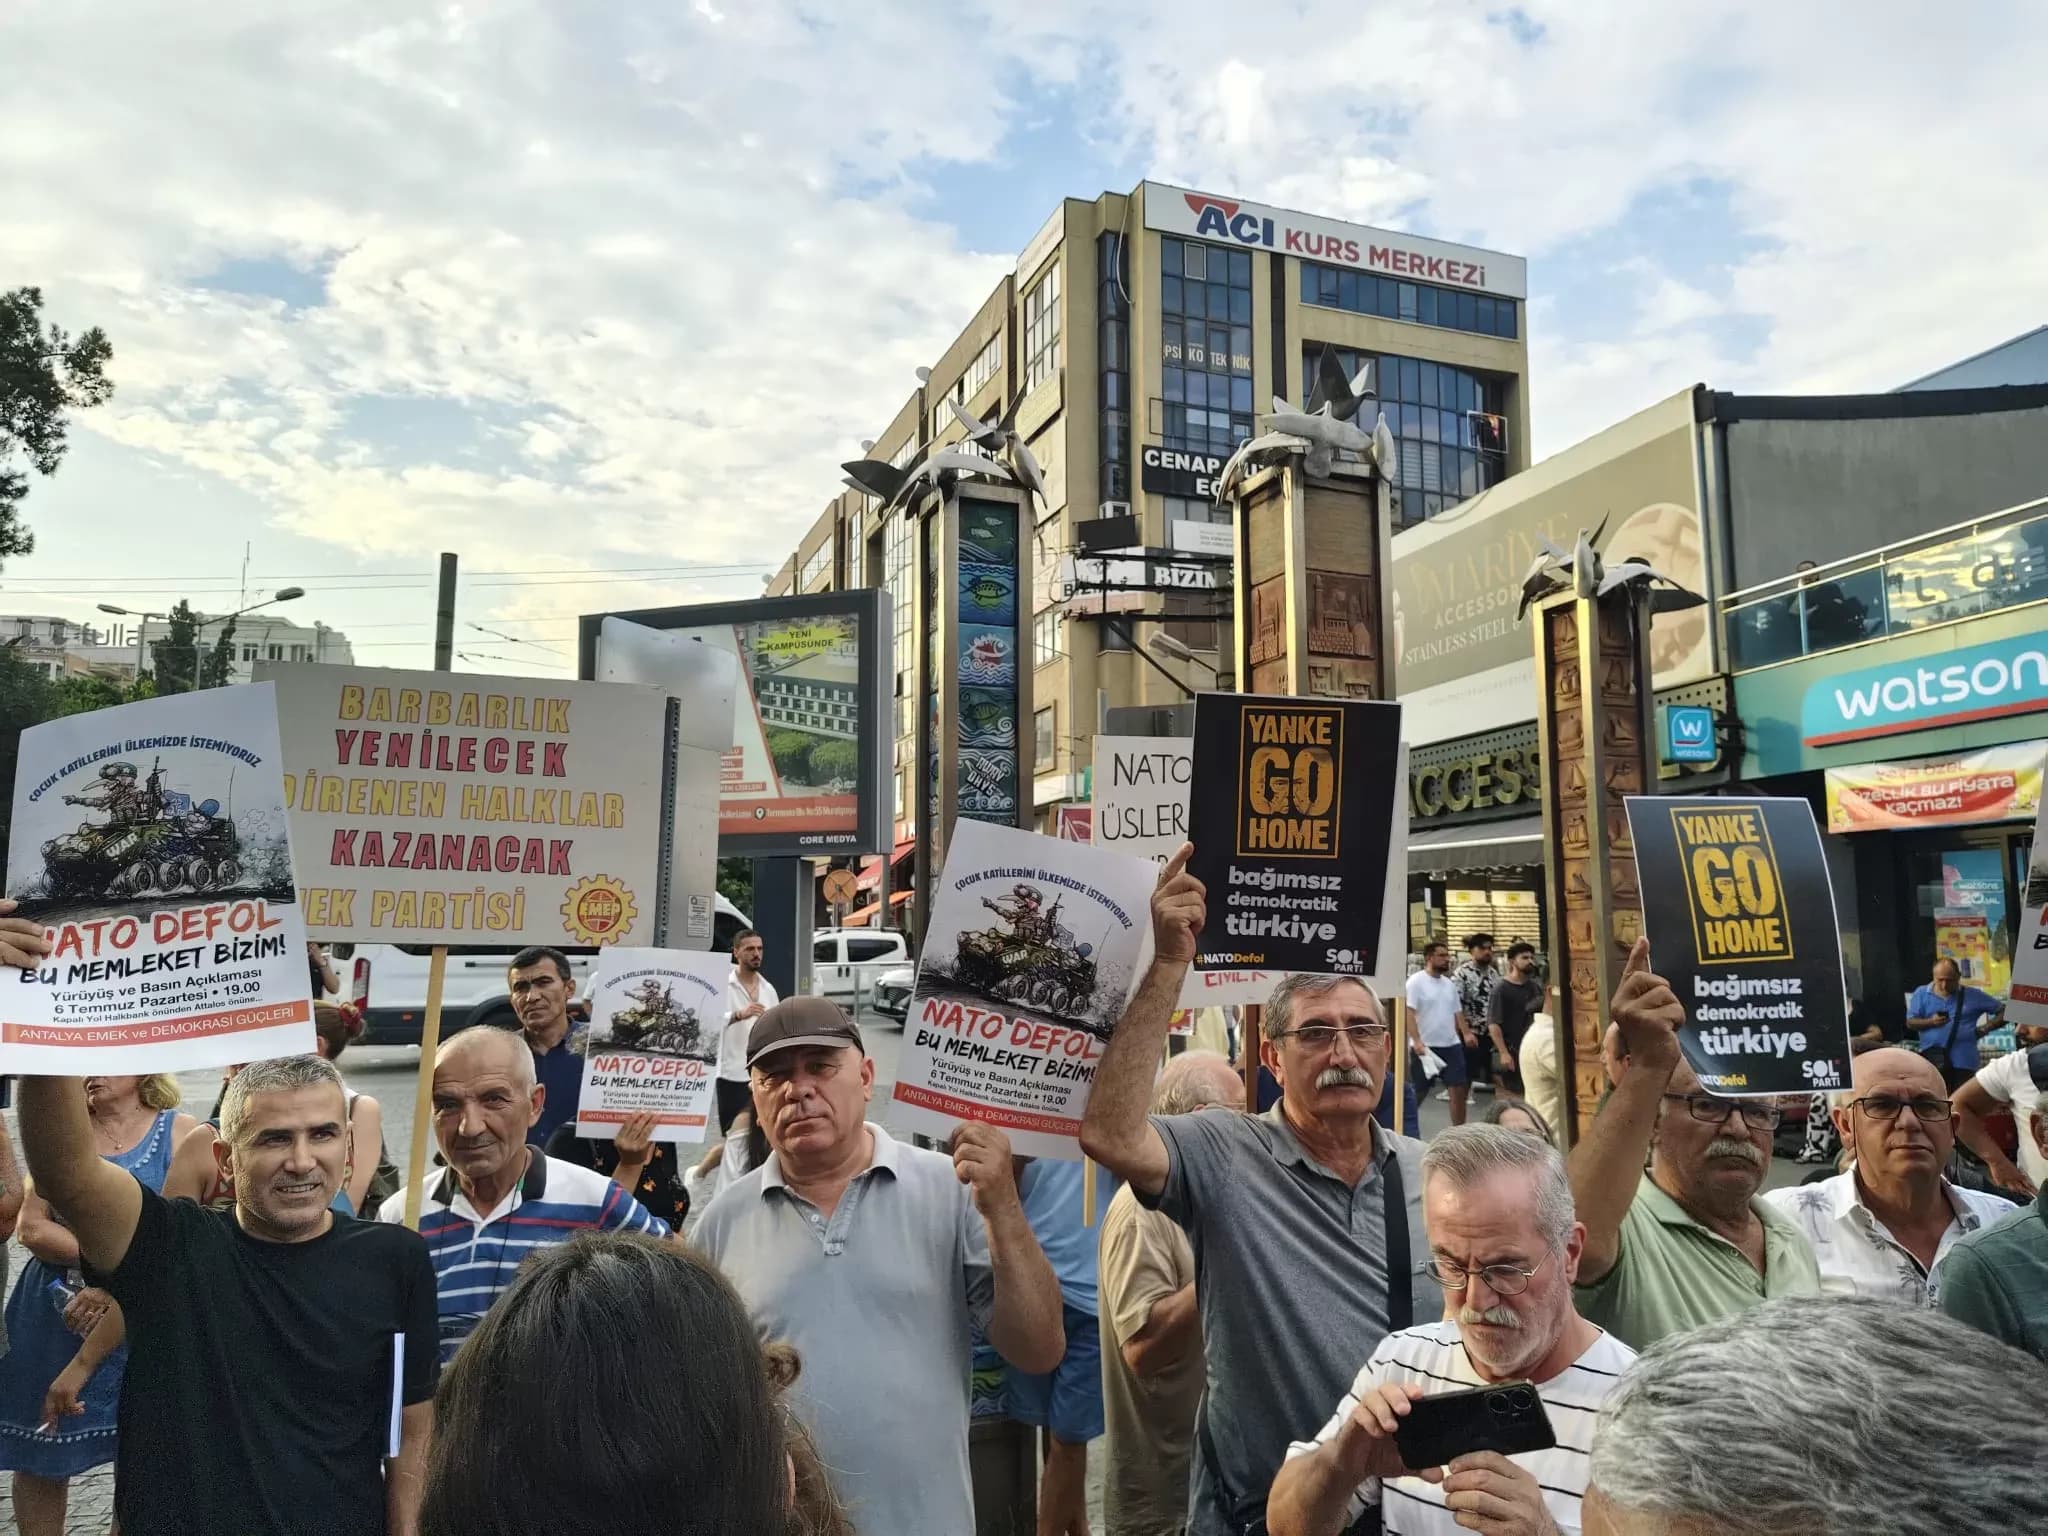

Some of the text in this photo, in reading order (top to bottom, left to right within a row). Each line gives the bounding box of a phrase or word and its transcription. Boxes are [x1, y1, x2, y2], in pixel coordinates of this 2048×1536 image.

[1196, 205, 1274, 247] ACI
[1285, 227, 1360, 263] KURS
[1209, 351, 1227, 367] TEK
[1144, 449, 1220, 474] CENAP
[1406, 631, 1467, 665] STAINLESS
[1470, 617, 1507, 645] STEEL
[338, 684, 572, 734] BARBARLIK
[1248, 714, 1333, 744] YANKE
[29, 735, 262, 803] ÇOCUK KATİLLERİNİ ÜLKEMİZDE İSTEMİYORUZ
[335, 728, 568, 778] YENİLECEK
[1113, 752, 1191, 786] NATO
[1249, 747, 1334, 817] GO
[460, 783, 625, 829] HALKLAR
[1101, 802, 1188, 841] ÜSLER
[106, 831, 138, 857] WAR
[799, 835, 857, 844] CORE MEDYA
[1249, 817, 1330, 850] HOME
[1679, 813, 1760, 845] YANKE
[330, 828, 573, 876] KAZANACAK
[1228, 866, 1342, 891] bağımsız
[1692, 845, 1777, 917] GO
[370, 885, 527, 931] PARTİSİ
[580, 901, 621, 917] EMEP
[955, 866, 1133, 931] ÇOCUK KATİLLERİNİ ÜLKEMİZDE İSTEMİYORUZ
[1227, 891, 1340, 912] demokratik
[154, 899, 283, 945] DEFOL
[1226, 912, 1337, 944] türkiye
[1704, 918, 1784, 954] HOME
[68, 945, 206, 985] MEMLEKET
[214, 932, 287, 965] BİZİM!
[1001, 949, 1029, 966] WAR
[1325, 948, 1364, 965] SOL
[51, 969, 262, 1002] Yürüyüş ve Basın Açıklaması
[54, 981, 260, 1014] 6 Temmuz Pazartesi 19.00
[1694, 974, 1802, 1001] bağımsız
[105, 1009, 149, 1021] Halkbank
[152, 1005, 192, 1016] önünden
[1696, 1000, 1804, 1022] demokratik
[20, 1029, 82, 1041] ANTALYA
[87, 1030, 128, 1041] EMEK
[132, 1030, 147, 1038] ve
[922, 1000, 1101, 1060] NATO DEFOL
[1699, 1024, 1808, 1059] türkiye
[594, 1055, 709, 1078] NATO DEFOL
[915, 1029, 1097, 1084] BU MEMLEKET BİZİM!
[1801, 1060, 1840, 1079] SOL
[591, 1076, 607, 1087] BU
[610, 1077, 672, 1090] MEMLEKET
[930, 1069, 1067, 1106] 6 Temmuz Pazartesi 19.00
[931, 1056, 1072, 1096] Yürüyüş ve Basın Açıklaması
[903, 1088, 943, 1108] ANTALYA
[944, 1100, 971, 1114] EMEK
[973, 1108, 983, 1118] ve
